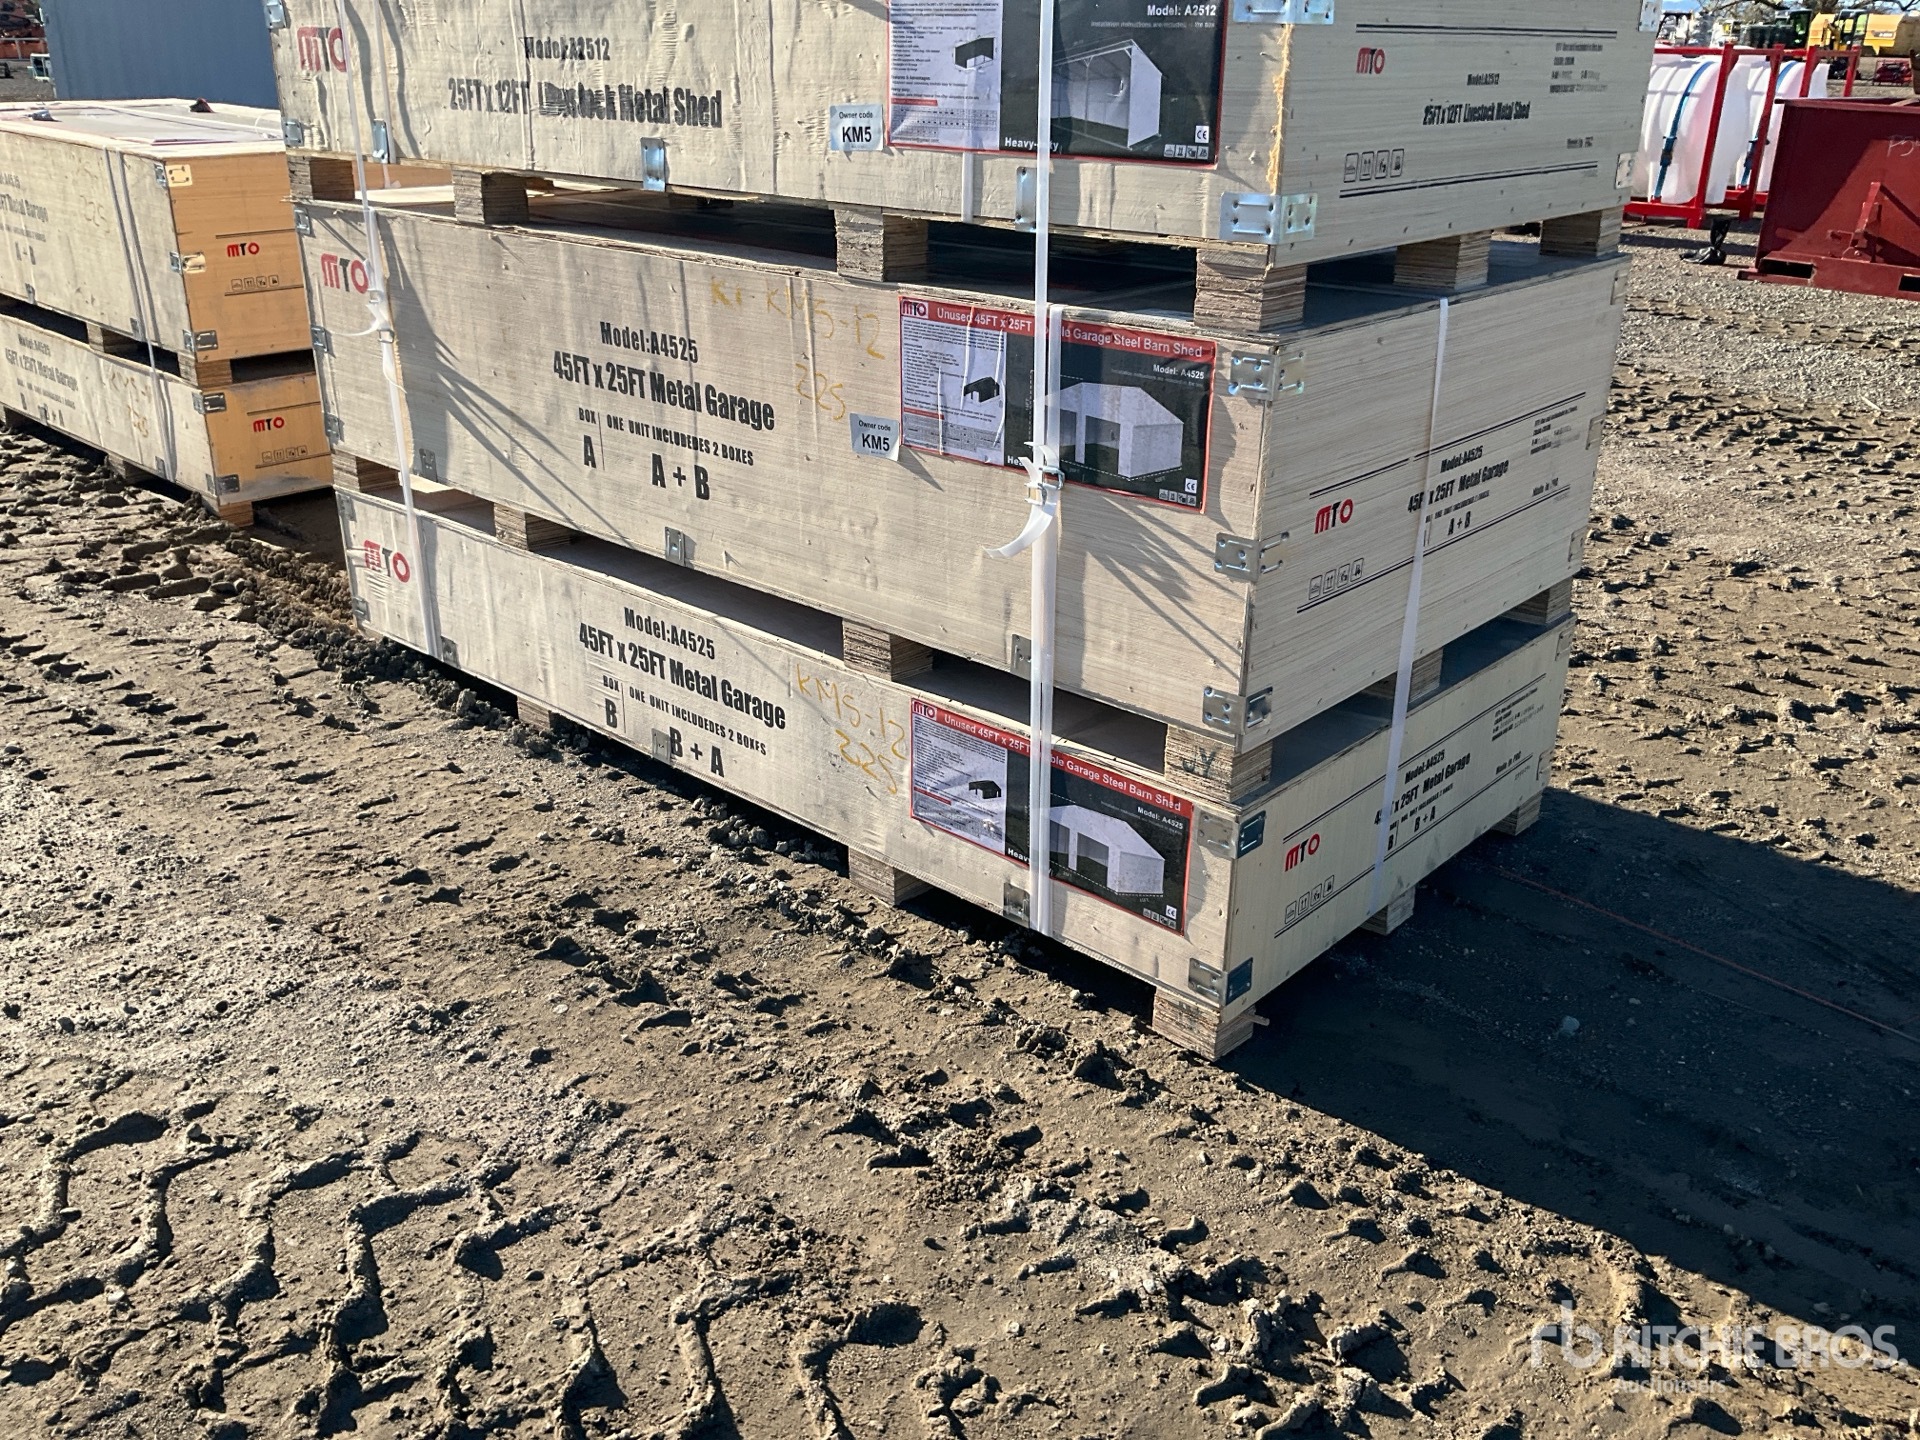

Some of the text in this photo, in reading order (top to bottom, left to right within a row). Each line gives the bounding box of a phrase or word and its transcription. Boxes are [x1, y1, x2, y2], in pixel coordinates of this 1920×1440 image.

[1147, 4, 1216, 16] Model: A2512
[297, 26, 347, 72] MTO
[1356, 47, 1385, 74] MTO
[448, 77, 482, 111] 25FT
[495, 78, 528, 114] 12FT
[672, 87, 722, 128] Shed
[839, 111, 873, 120] Owner code
[842, 126, 872, 142] KM5
[226, 242, 260, 258] MTO
[320, 253, 369, 294] MTO
[600, 321, 698, 364] Model:A4525
[901, 301, 927, 317] MTO
[938, 308, 972, 323] Unused
[974, 314, 998, 327] 45FT
[1000, 319, 1006, 328] x
[1009, 317, 1032, 332] 25FT
[1073, 328, 1111, 345] Garage
[1113, 333, 1141, 349] Steel
[1144, 338, 1170, 354] Barn
[1173, 342, 1203, 358] Shed
[1153, 364, 1178, 376] Model:
[1180, 368, 1205, 380] A4525
[553, 350, 774, 431] 45FT x 25FT Metal Garage
[252, 416, 285, 433] MTO
[578, 407, 596, 424] BOX
[858, 420, 892, 432] Owner code
[583, 434, 596, 469] A
[606, 414, 624, 431] ONE
[628, 420, 650, 438] UNIT
[712, 442, 719, 457] 2
[721, 444, 754, 466] BOXES
[861, 433, 890, 451] KM5
[652, 453, 666, 488] A
[694, 464, 710, 500] B
[1440, 445, 1483, 473] Model:A4525
[1434, 479, 1455, 503] 25FT
[1458, 468, 1482, 492] Metal
[1482, 460, 1509, 482] Garage
[1314, 498, 1353, 534] MTO
[363, 539, 411, 583] MTO
[624, 607, 715, 660] Model:A4525
[580, 623, 786, 730] 45FT x 25FT Metal Garage
[603, 675, 619, 692] BOX
[605, 698, 617, 729] B
[629, 686, 645, 704] ONE
[650, 694, 669, 714] UNIT
[728, 729, 733, 742] 2
[736, 732, 766, 756] BOXES
[669, 726, 683, 758] B
[710, 745, 724, 778] A
[913, 701, 936, 720] MTO
[944, 713, 976, 734] Unused
[978, 728, 1000, 742] 45FT
[1001, 736, 1006, 745] x
[1009, 738, 1031, 753] 25FT
[1066, 760, 1100, 780] Garage
[1102, 774, 1126, 791] Steel
[1129, 783, 1152, 800] Barn
[1155, 795, 1181, 811] Shed
[1405, 749, 1445, 784] Model:A4525
[1400, 784, 1420, 809] 25FT
[1423, 768, 1444, 794] Metal
[1445, 753, 1470, 779] Garage
[1138, 806, 1160, 822] Model:
[1162, 816, 1183, 830] A4525
[1414, 816, 1420, 832] B
[1430, 805, 1435, 822] A
[1284, 833, 1321, 872] MTO
[1388, 834, 1394, 851] B
